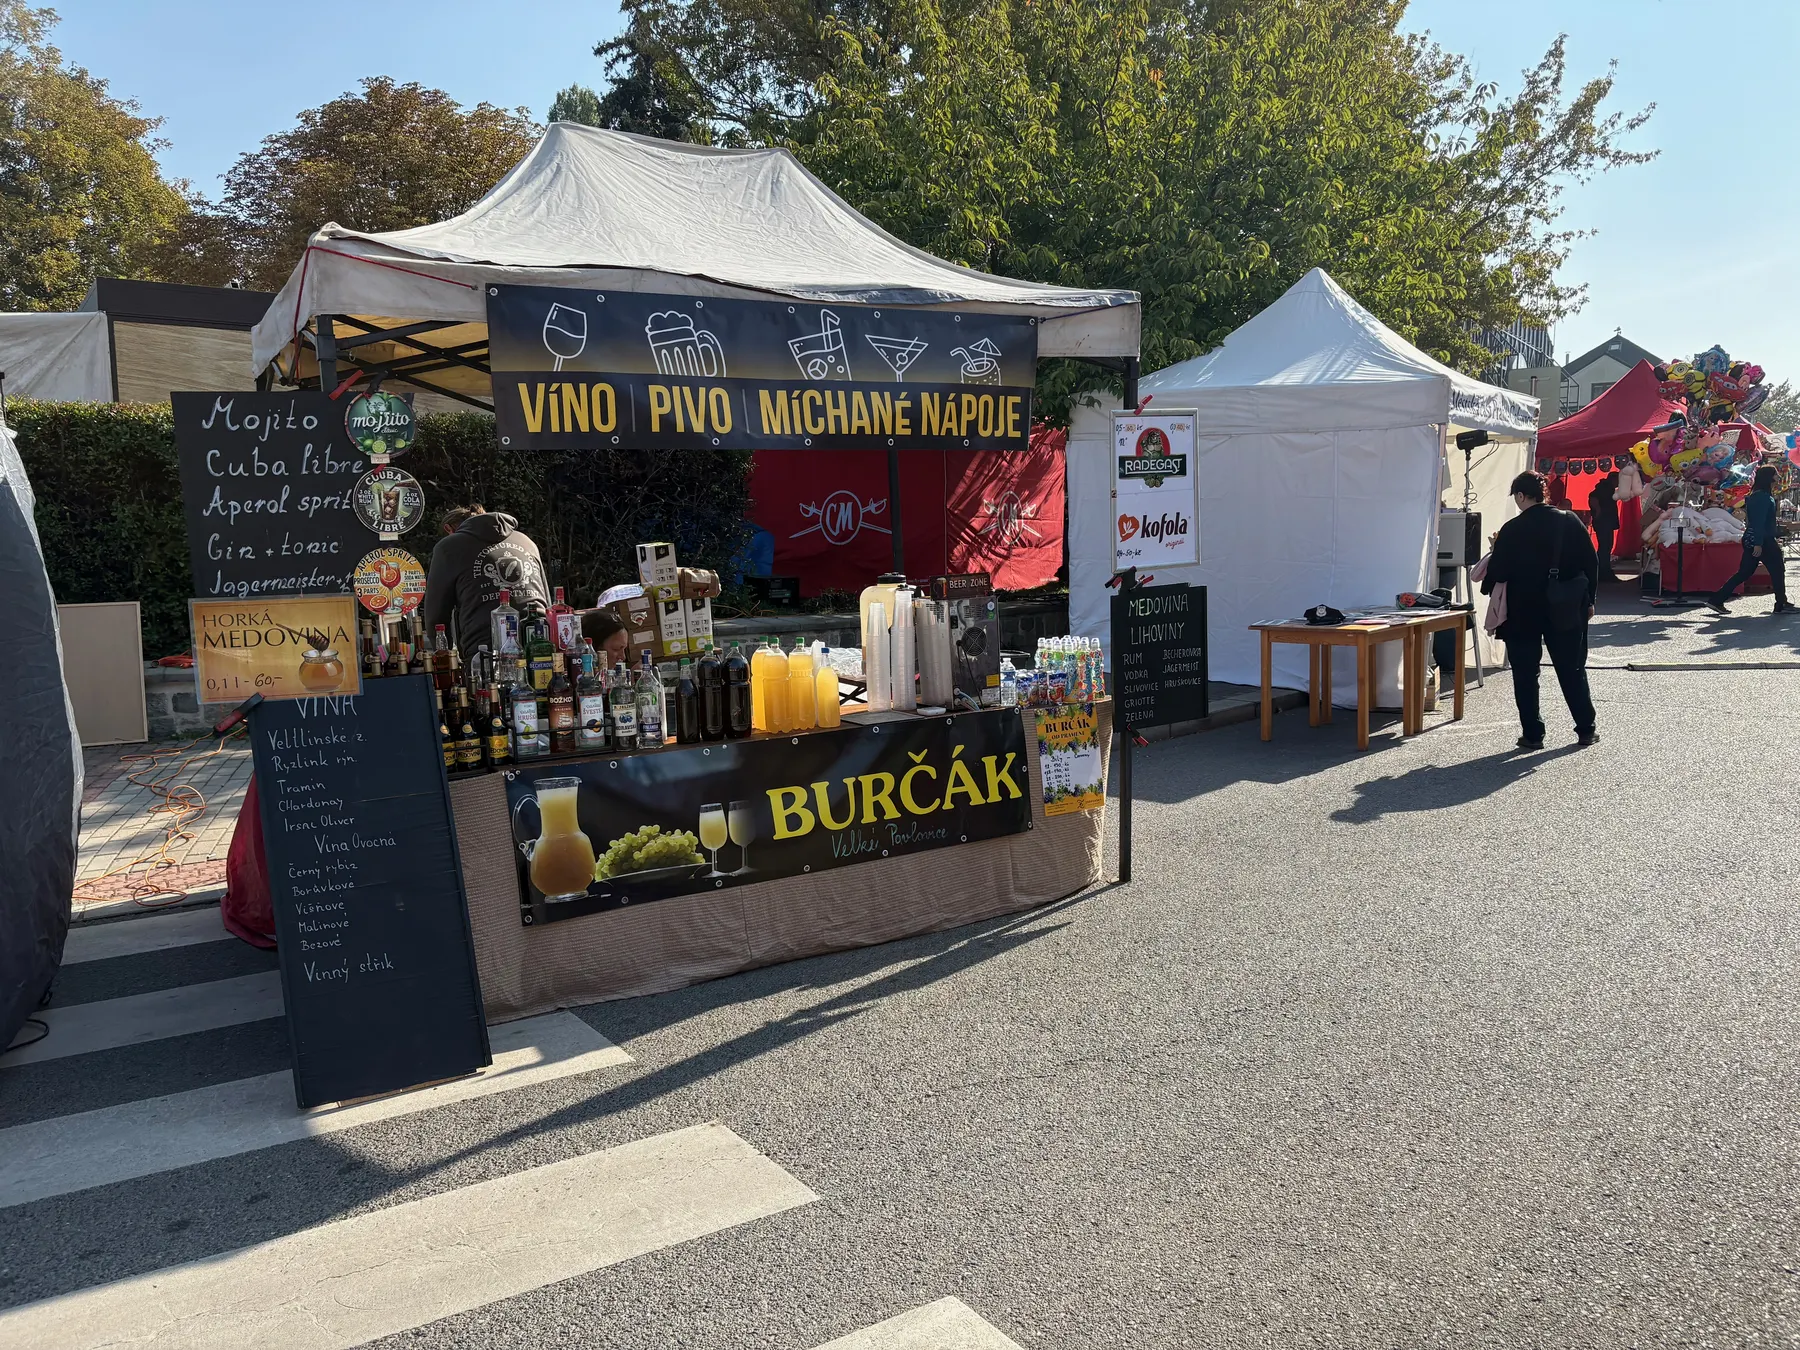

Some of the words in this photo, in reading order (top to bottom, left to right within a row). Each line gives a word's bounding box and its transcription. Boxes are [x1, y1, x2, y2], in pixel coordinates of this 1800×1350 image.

[201, 395, 318, 442] Mojito
[650, 385, 733, 435] PIVO
[921, 391, 1022, 439] NÁPOJE
[206, 446, 290, 477] Cuba
[300, 443, 365, 475] libre
[1125, 458, 1182, 475] RADEGAST
[203, 485, 290, 525] Aperol
[297, 490, 354, 518] sprit
[372, 519, 406, 532] LIBRE
[1140, 512, 1188, 543] kofola
[207, 532, 256, 560] Gin
[265, 548, 274, 557] +
[281, 531, 340, 556] tonic
[477, 542, 525, 559] TORTURED
[358, 549, 385, 572] APEROL
[473, 560, 483, 579] THE
[357, 587, 363, 598] 3
[949, 580, 967, 588] BEER
[970, 578, 988, 586] ZONE
[482, 588, 541, 603] DEPRTMENT
[1128, 593, 1189, 617] MEDOVINA
[202, 608, 274, 628] HORKÁ
[203, 625, 350, 649] MEDOVINA
[1131, 622, 1185, 645] LIHOVINY
[1122, 652, 1143, 666] RUM
[1162, 647, 1202, 660] BECHEROVKA
[1124, 669, 1149, 681] VODKA
[1124, 682, 1159, 695] SLIVOVICE
[1124, 696, 1155, 709] GRIOTTE
[1045, 717, 1090, 733] BURČÁK
[271, 750, 329, 774] Ryzlink
[765, 745, 1023, 841] BURČÁK
[320, 814, 355, 827] Oliver
[288, 861, 320, 879] Černý
[298, 912, 350, 933] Malinové
[300, 933, 342, 951] Bezové
[303, 958, 349, 984] Vinný
